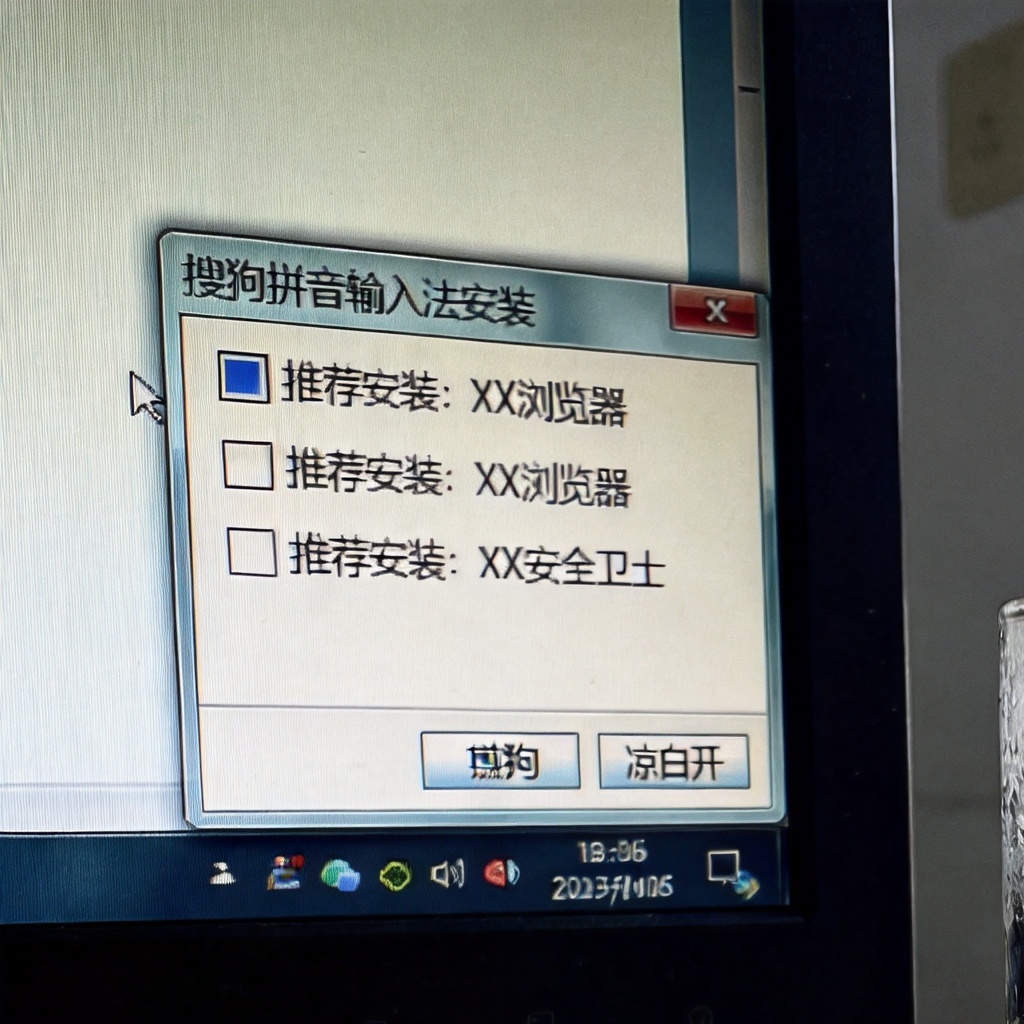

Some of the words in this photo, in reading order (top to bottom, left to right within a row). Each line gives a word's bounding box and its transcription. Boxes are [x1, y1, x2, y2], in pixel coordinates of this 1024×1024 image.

[181, 253, 537, 328] 搜狗拼音输入法安装
[626, 742, 725, 781] 凉白开
